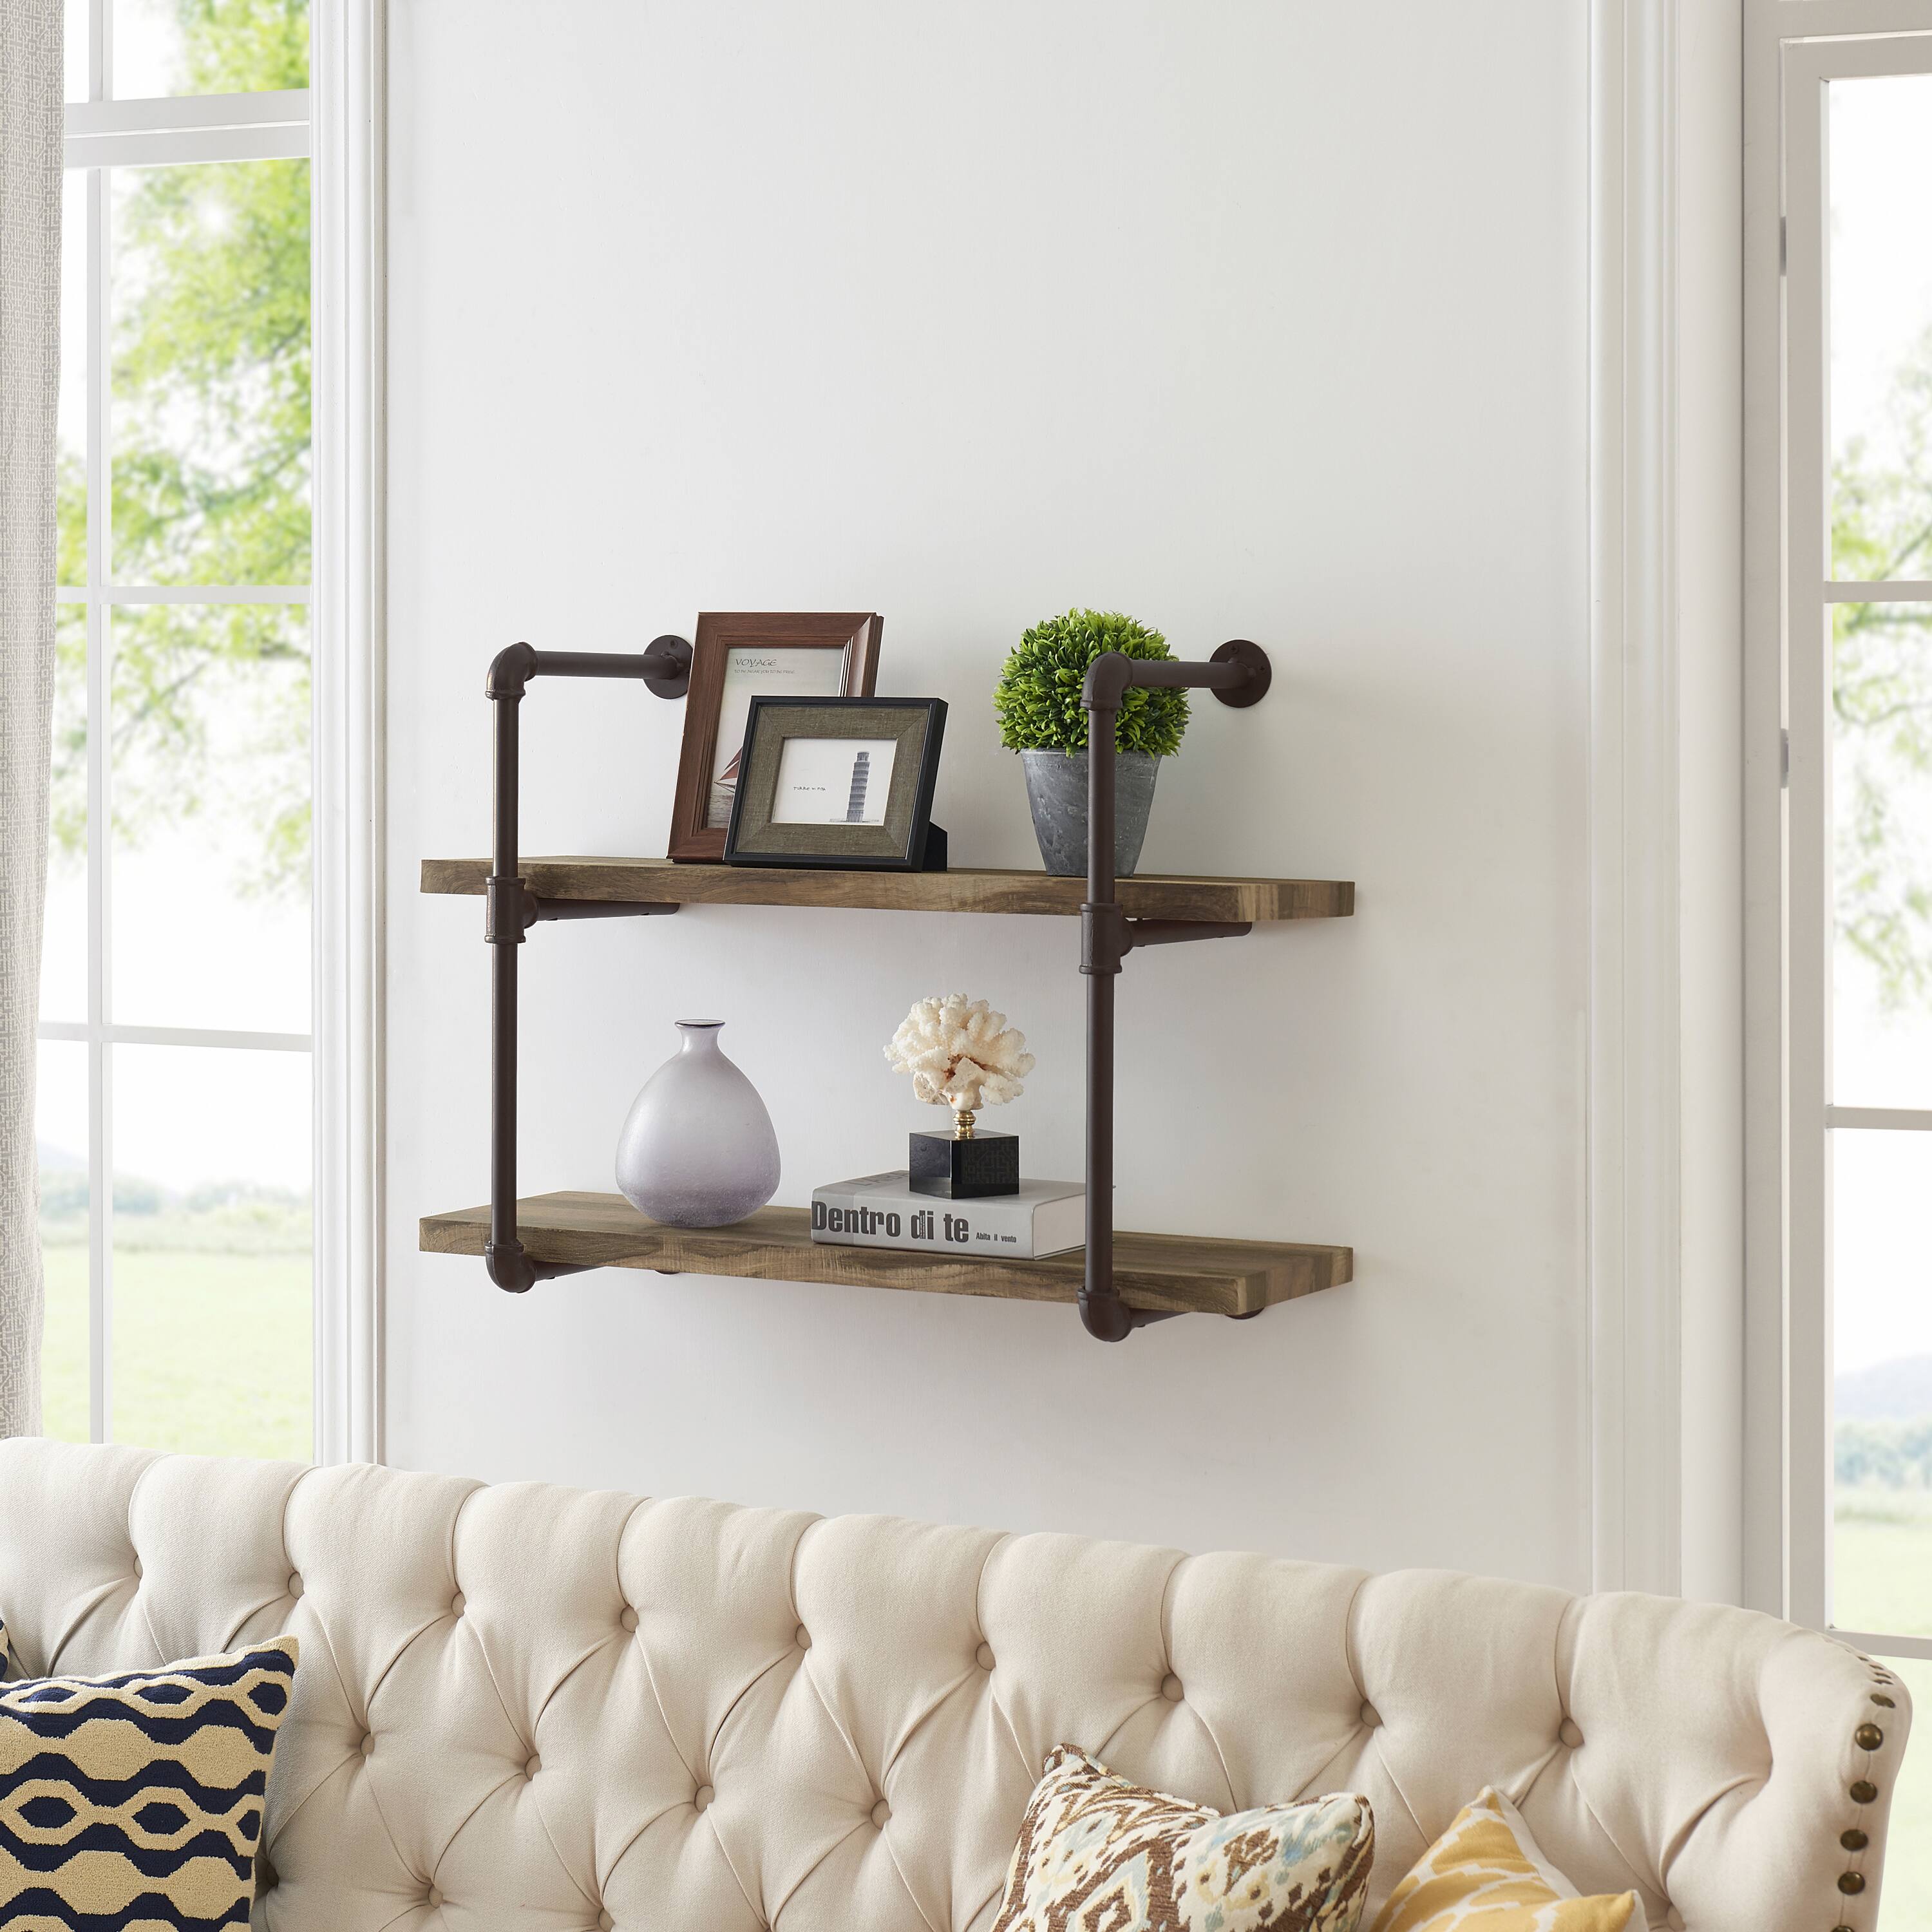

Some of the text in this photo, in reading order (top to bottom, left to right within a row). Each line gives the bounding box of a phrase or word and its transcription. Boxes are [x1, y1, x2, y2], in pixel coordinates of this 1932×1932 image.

[735, 659, 777, 667] VOYAGE
[811, 1201, 901, 1237] Dentro
[911, 1210, 934, 1240] di
[943, 1213, 969, 1243] te
[976, 1232, 990, 1240] Abita
